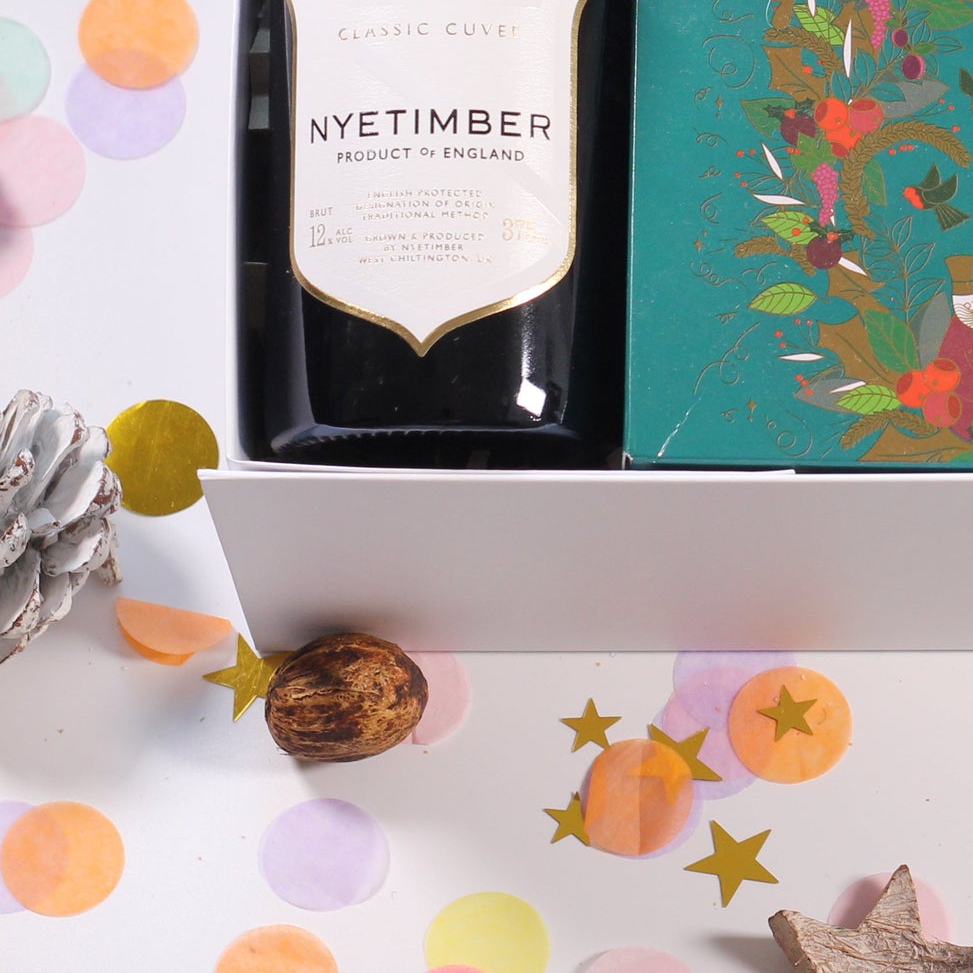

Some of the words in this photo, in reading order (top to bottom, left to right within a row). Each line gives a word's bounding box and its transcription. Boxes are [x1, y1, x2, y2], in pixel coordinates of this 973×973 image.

[338, 22, 429, 41] CLASSIC
[310, 108, 551, 144] NYETIMBER
[337, 147, 412, 164] PRODUCT
[443, 147, 525, 163] ENGLAND
[417, 189, 482, 198] PROTECTED
[435, 200, 449, 208] OF
[309, 207, 334, 219] BRUT
[335, 227, 353, 236] ALC
[335, 235, 353, 244] VOL
